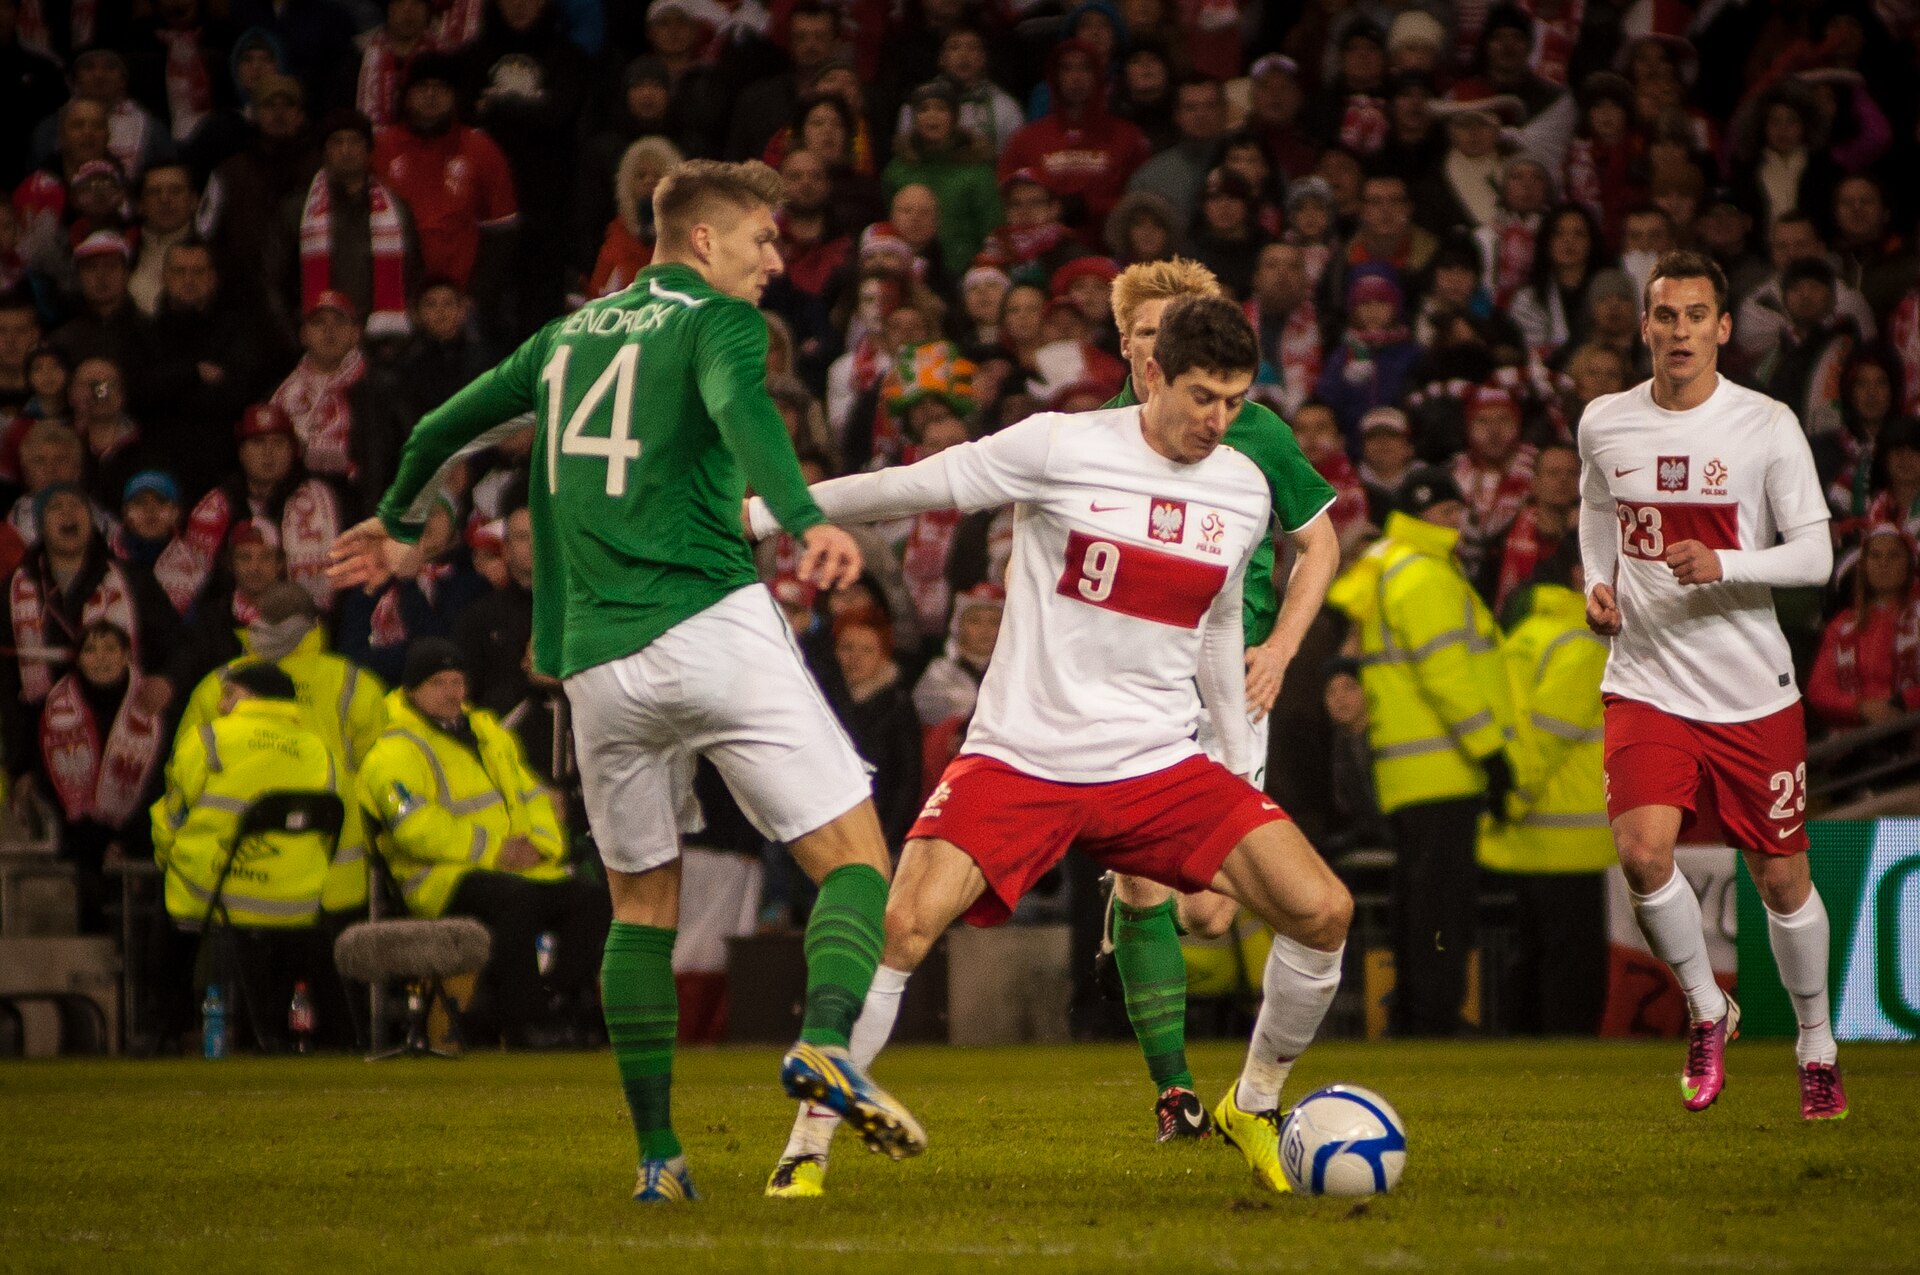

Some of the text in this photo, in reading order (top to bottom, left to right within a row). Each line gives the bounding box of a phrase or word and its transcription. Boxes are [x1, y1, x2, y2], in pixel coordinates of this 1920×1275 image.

[560, 303, 675, 335] ENDRICK
[541, 343, 641, 496] 14
[1618, 504, 1664, 557] 23
[1078, 541, 1121, 602] 9
[1769, 761, 1807, 819] 23
